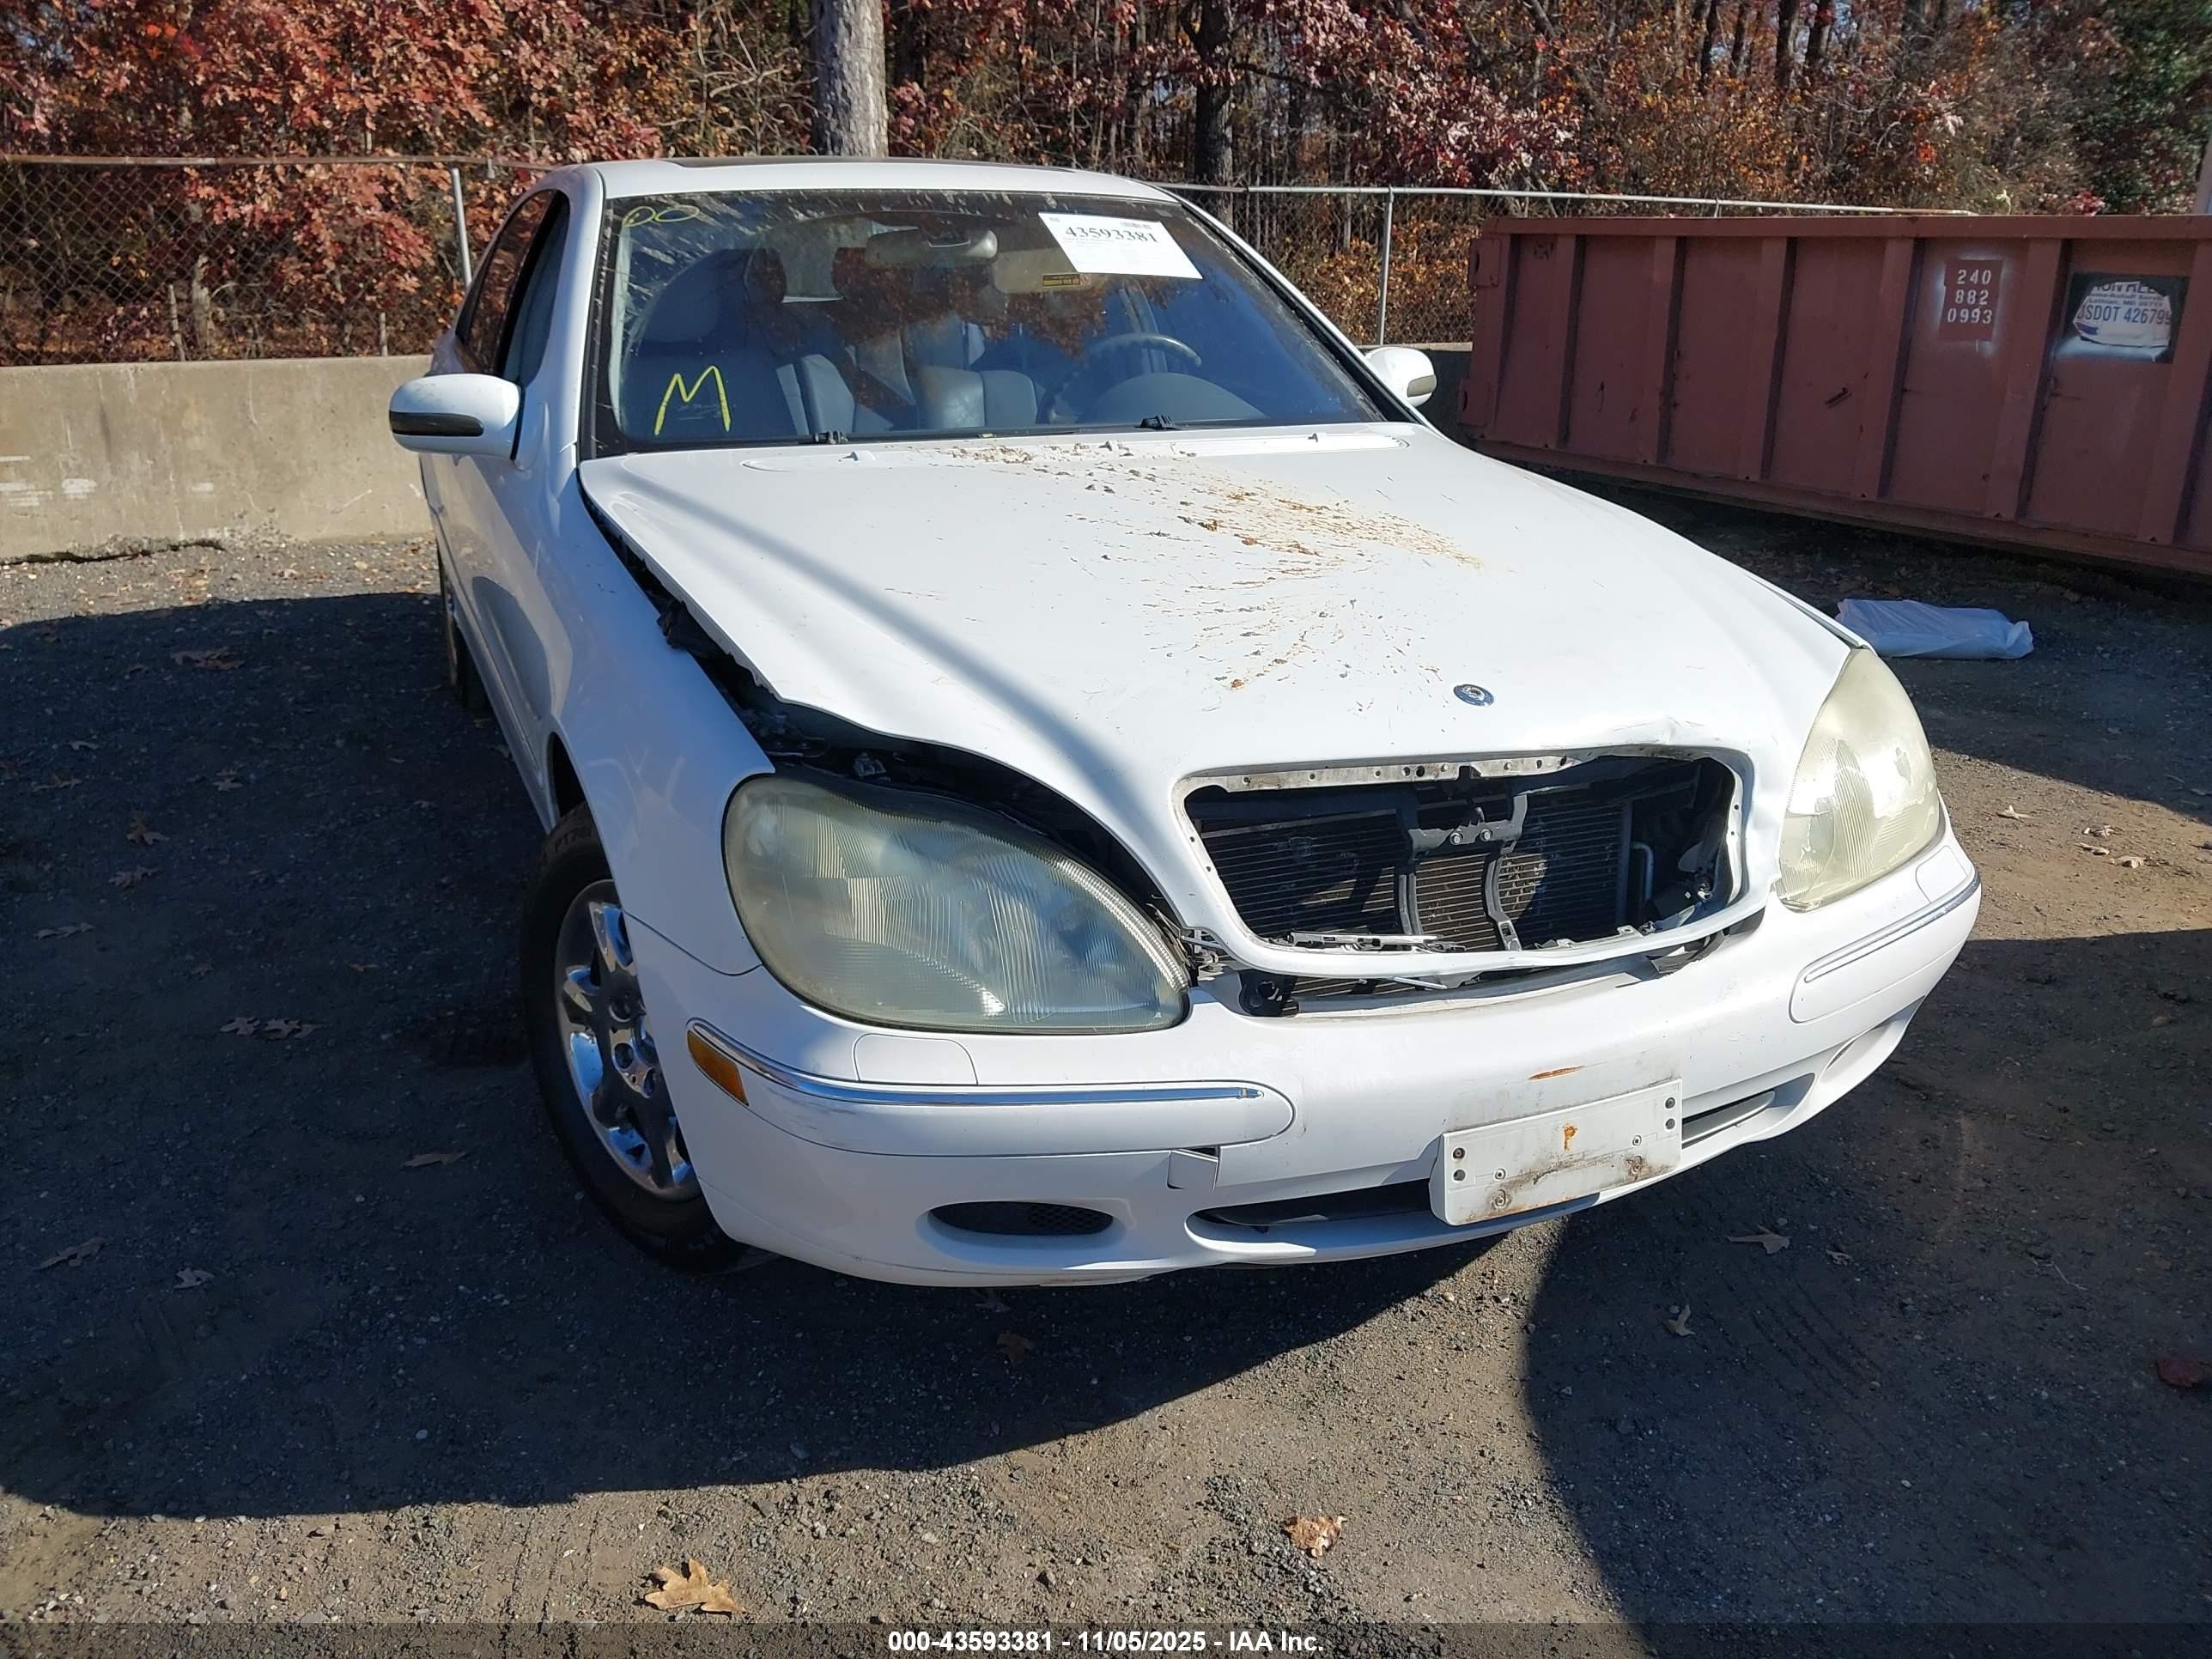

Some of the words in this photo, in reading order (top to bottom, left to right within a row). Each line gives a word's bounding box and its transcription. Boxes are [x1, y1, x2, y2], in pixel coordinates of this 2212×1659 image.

[1066, 227, 1158, 243] 43593381
[1957, 269, 1992, 285] 240
[1954, 289, 1989, 305] 882
[1948, 307, 1993, 325] 0993
[654, 365, 732, 435] M
